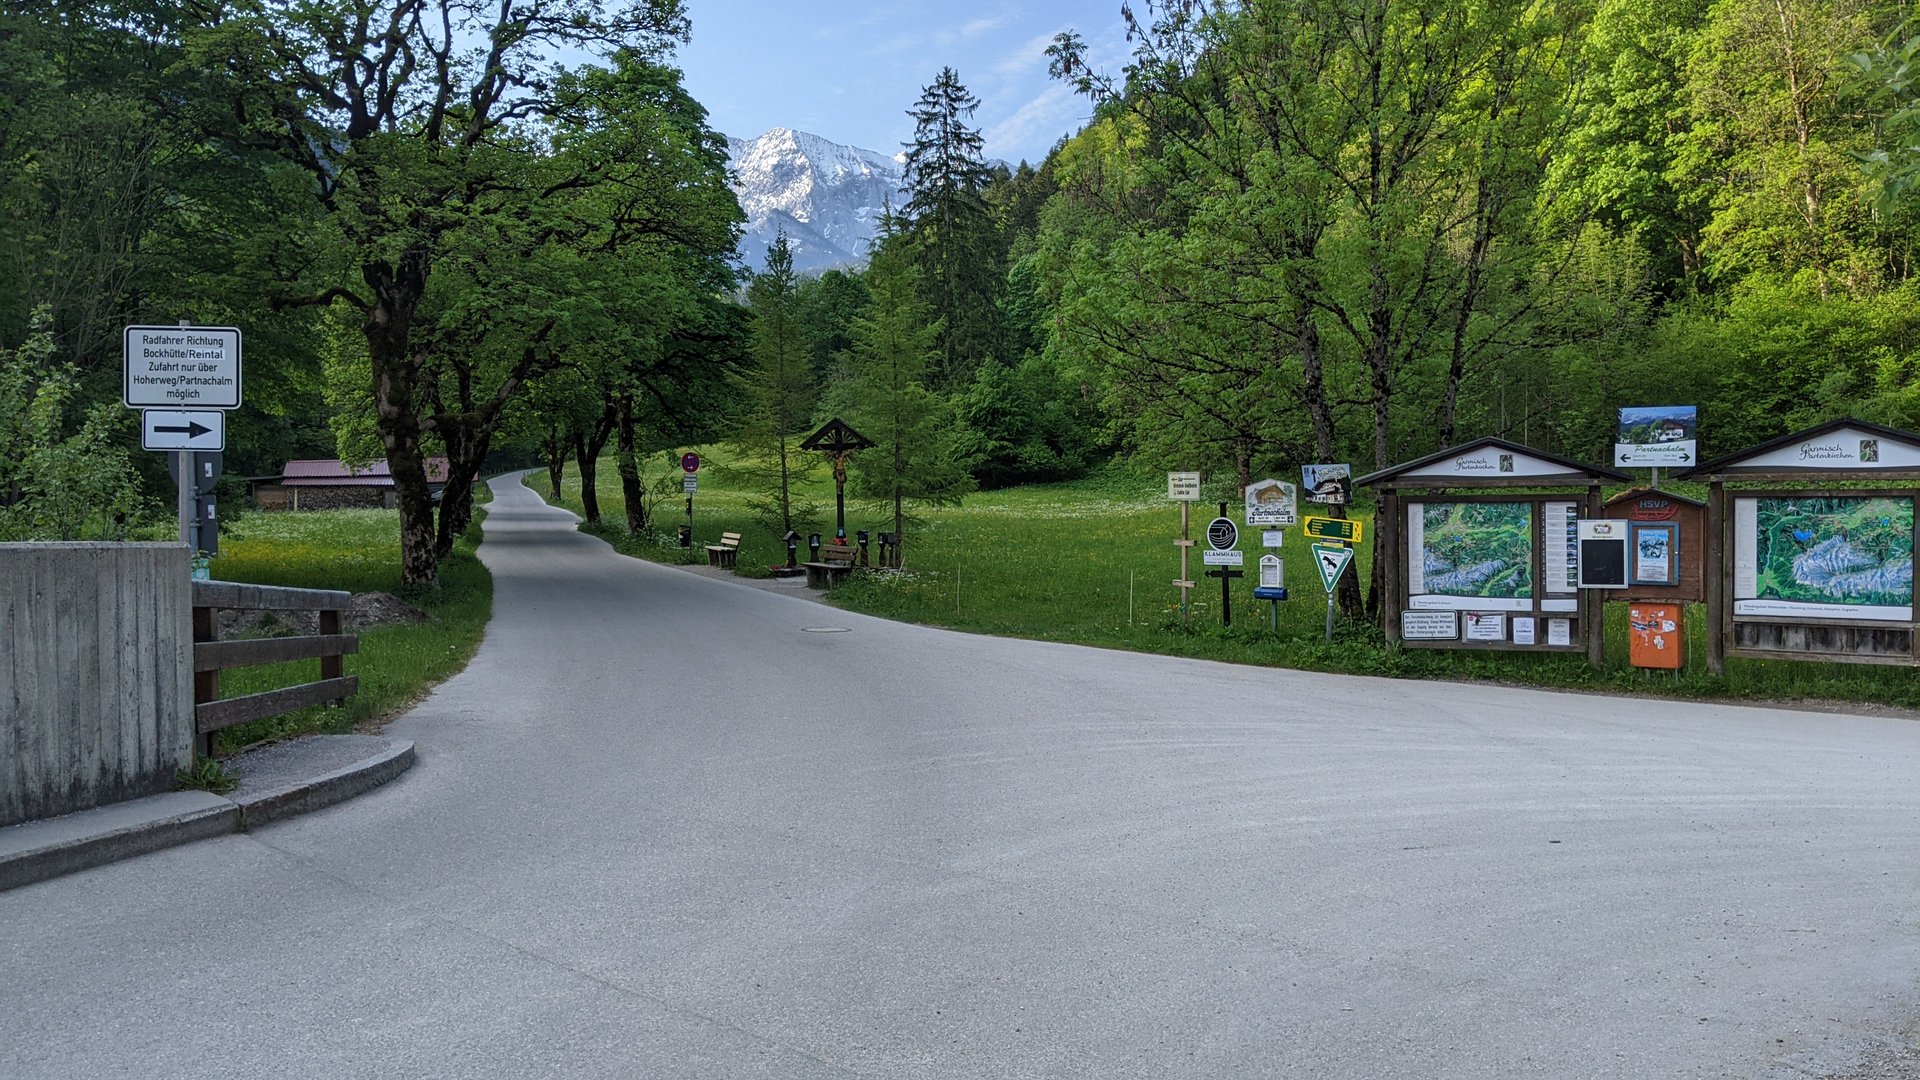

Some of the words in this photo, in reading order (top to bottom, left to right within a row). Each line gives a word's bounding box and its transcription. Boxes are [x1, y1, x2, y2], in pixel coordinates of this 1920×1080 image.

[143, 335, 184, 345] Radfahrer
[187, 336, 224, 347] Richtung
[143, 349, 223, 359] Bockhütte/Reintal
[149, 362, 179, 372] Zufahrt
[181, 364, 196, 372] nur
[198, 362, 218, 372] über
[133, 375, 233, 387] Hoherweg/Partnachalm
[166, 389, 200, 400] möglich
[1635, 445, 1686, 453] Partnachalm
[1800, 443, 1843, 453] Garmisch
[1456, 456, 1487, 465] Garmisch
[1799, 450, 1855, 461] Partenkirchen
[1640, 500, 1668, 509] HSVP
